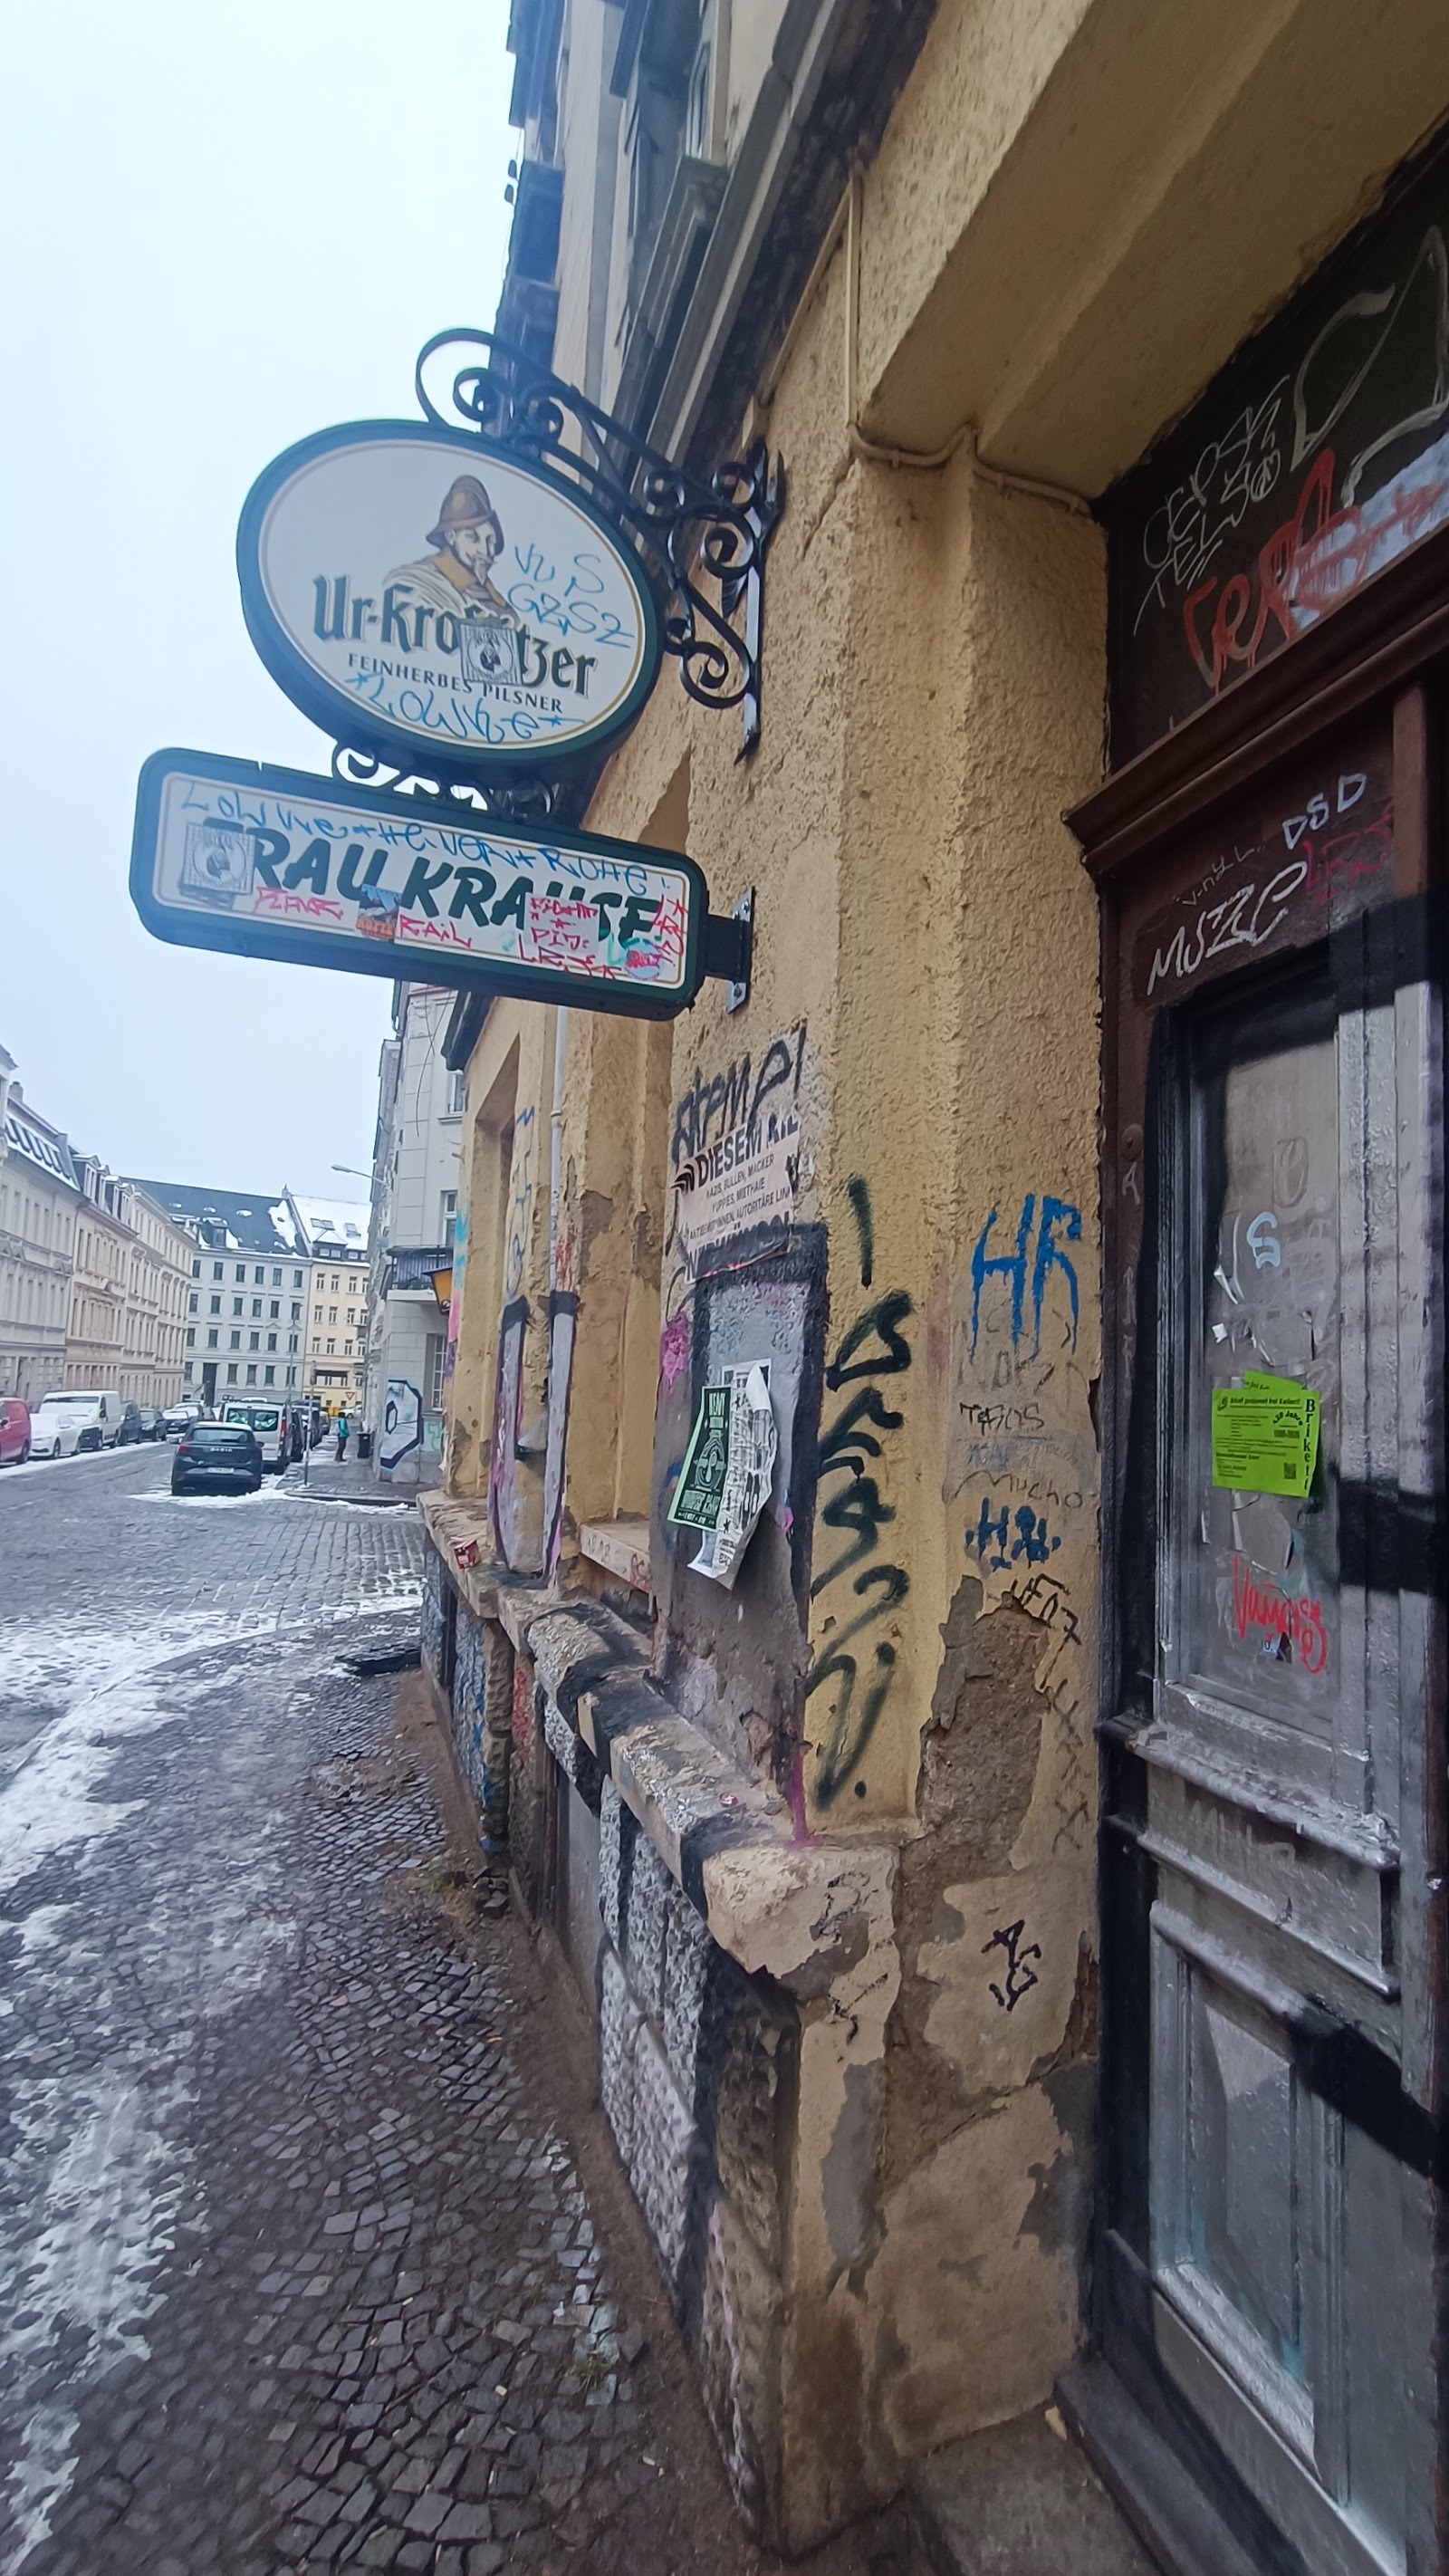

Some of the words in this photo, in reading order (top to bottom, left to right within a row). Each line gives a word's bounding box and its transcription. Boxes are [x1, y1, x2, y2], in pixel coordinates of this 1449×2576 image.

[313, 573, 597, 700] Ur-Krotzer
[348, 652, 473, 695] FEINHERBES
[483, 682, 563, 714] PILSNER
[203, 816, 389, 902] RAU
[695, 1126, 762, 1188] DIESEM
